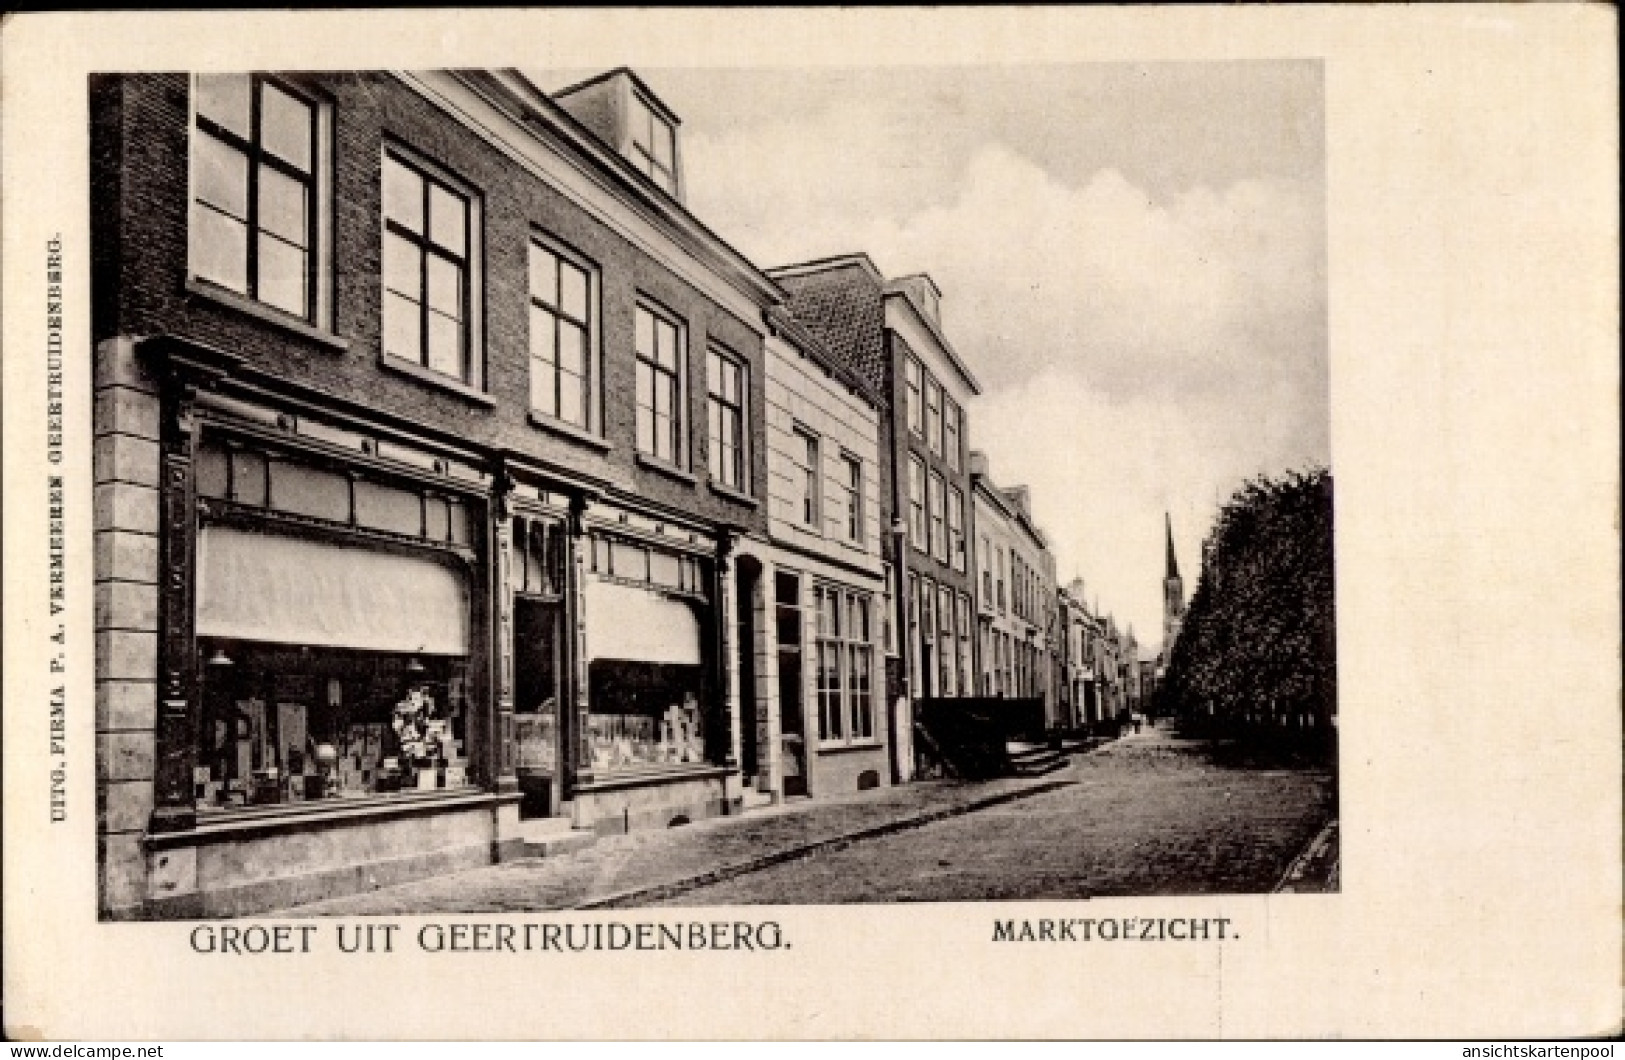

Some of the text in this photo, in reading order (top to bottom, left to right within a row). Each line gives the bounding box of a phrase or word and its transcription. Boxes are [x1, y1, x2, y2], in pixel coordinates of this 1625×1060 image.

[47, 232, 63, 466] GEERTRUIDENBERG.
[50, 623, 65, 645] A.
[50, 652, 65, 673] P.
[50, 683, 65, 756] FIRMA
[50, 761, 67, 824] UITG.
[190, 921, 792, 955] GROET UIT GEERTRUIDENBERG.
[991, 916, 1240, 942] MARKTGEZICHT.
